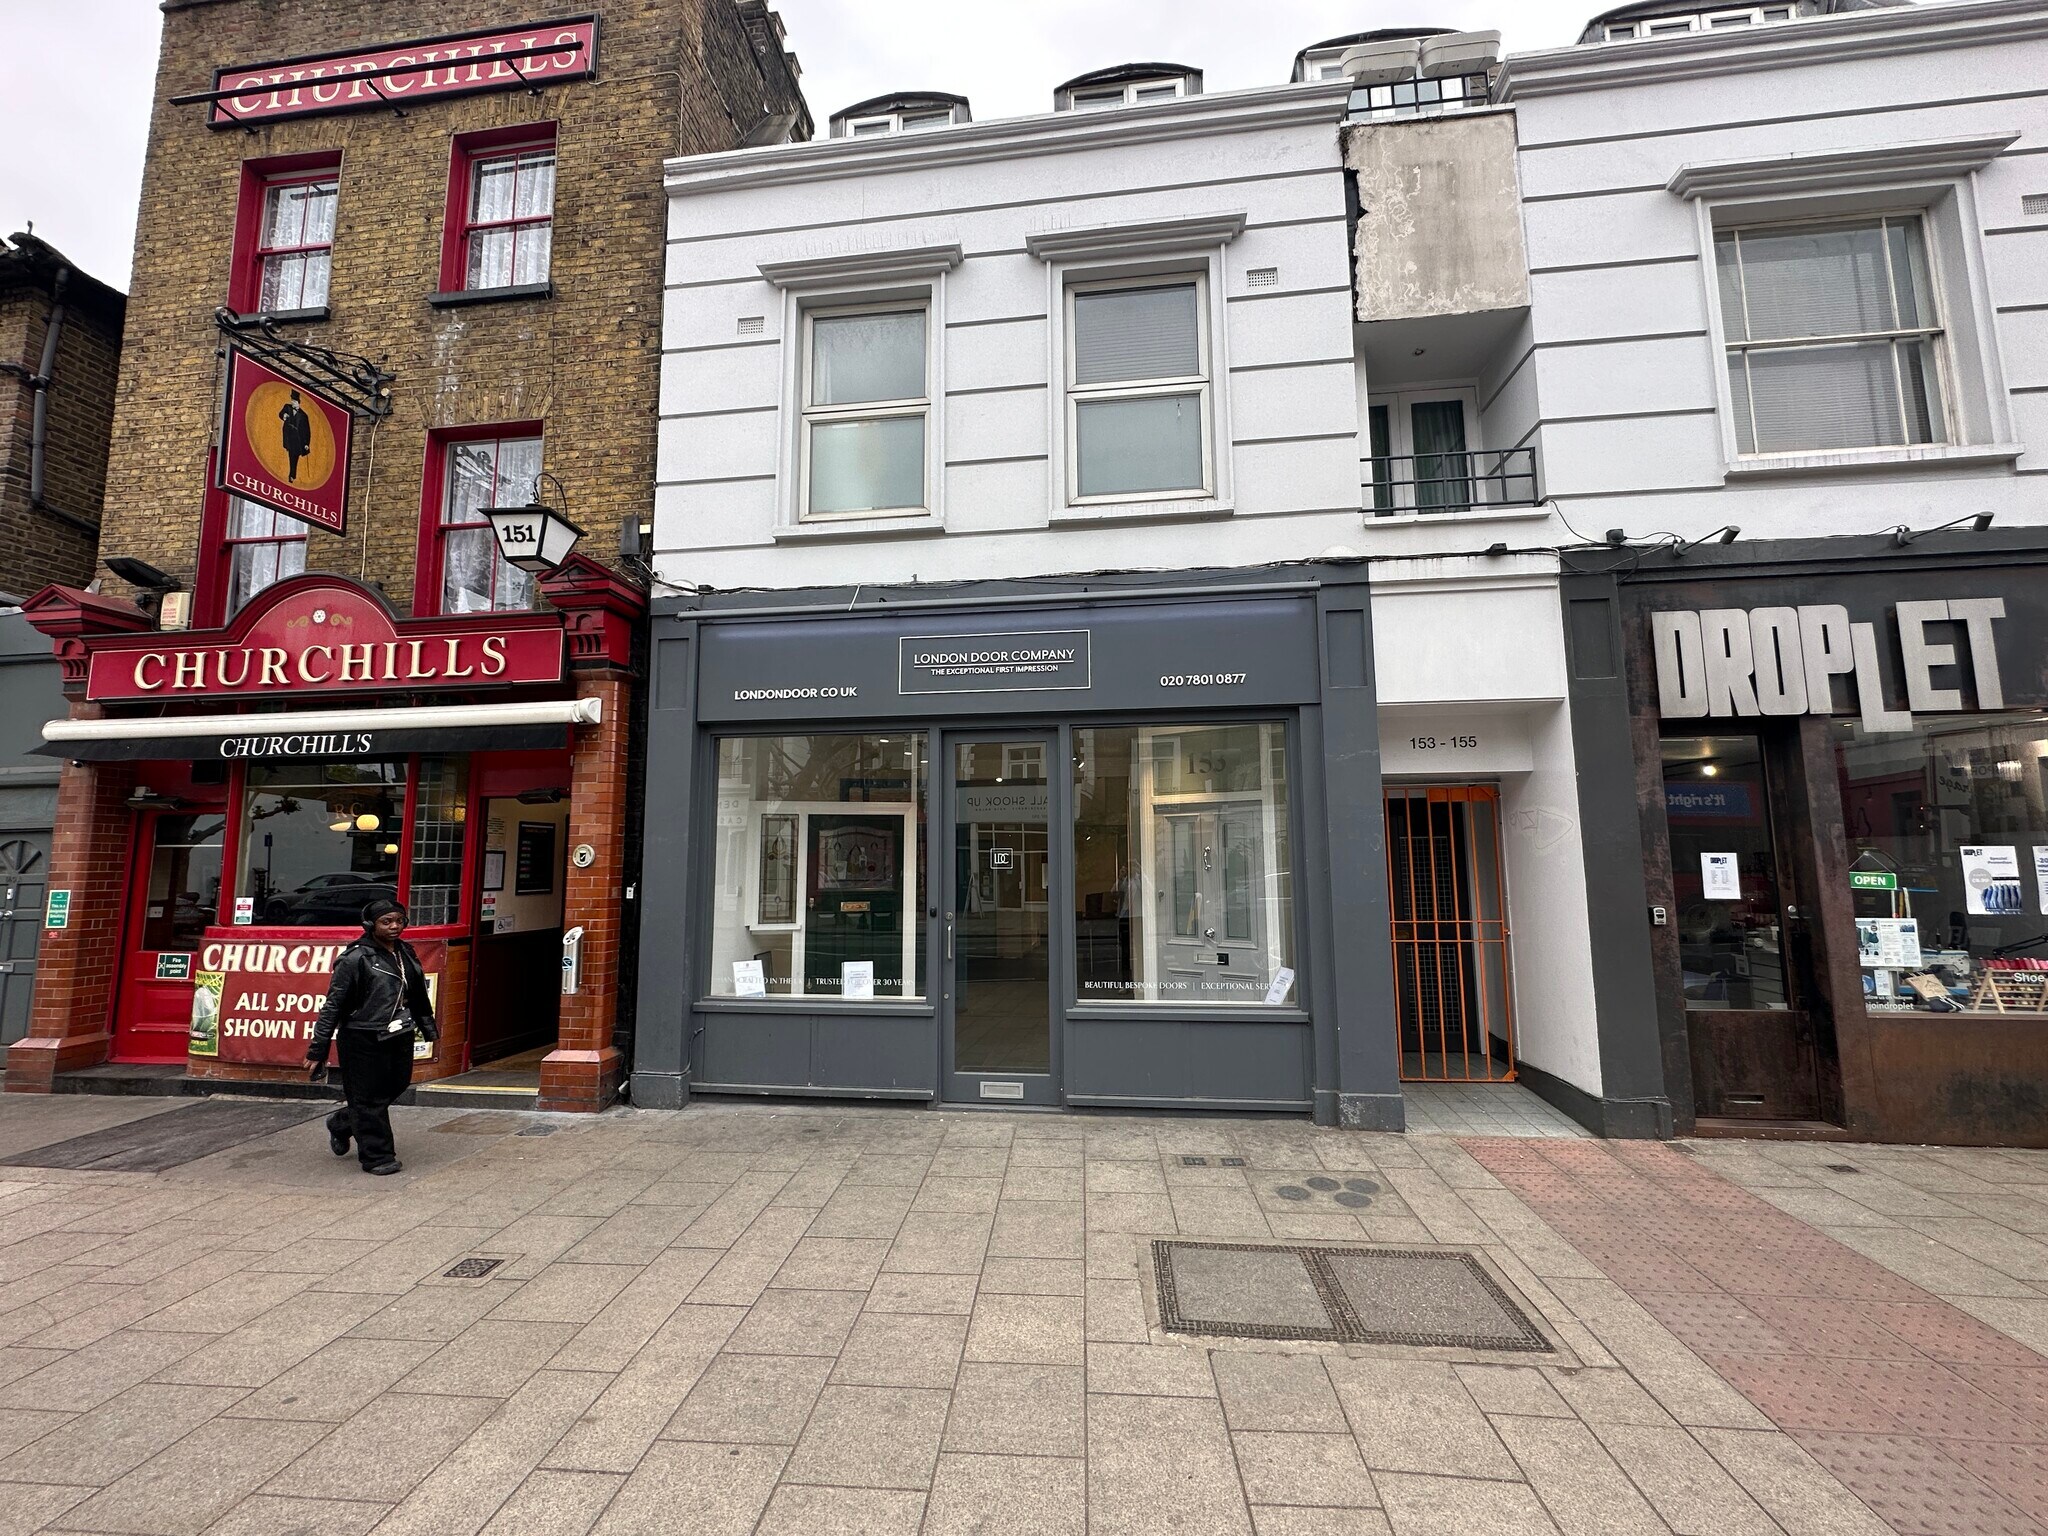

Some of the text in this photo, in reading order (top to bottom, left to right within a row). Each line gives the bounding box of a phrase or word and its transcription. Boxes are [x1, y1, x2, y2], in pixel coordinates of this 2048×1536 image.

[231, 32, 578, 114] CHURCHILLS
[233, 472, 338, 523] CHURCHILLS
[502, 525, 537, 543] 151
[134, 636, 507, 690] CHURCHILLS
[914, 649, 1075, 664] LONDON DOOR COMPANY
[931, 664, 1059, 676] THE EXCEPTIONAL FIRST IMPRESSION
[1652, 597, 2007, 733] DROPLET
[1160, 673, 1247, 687] 020 7801 0877
[734, 686, 858, 700] LONDONDOOR CO UK
[219, 733, 373, 758] CHURCHILL'S
[1409, 737, 1436, 749] 153
[1450, 735, 1477, 748] 155
[1854, 875, 1887, 886] OPEN
[882, 978, 892, 986] 30
[2013, 972, 2045, 982] Shoe
[1084, 981, 1187, 990] BEAUTIFUL BESPOKE DOORS
[1201, 982, 1254, 990] EXCEPTIONAL
[234, 992, 327, 1013] ALL SPOR
[223, 1018, 297, 1039] SHOWN
